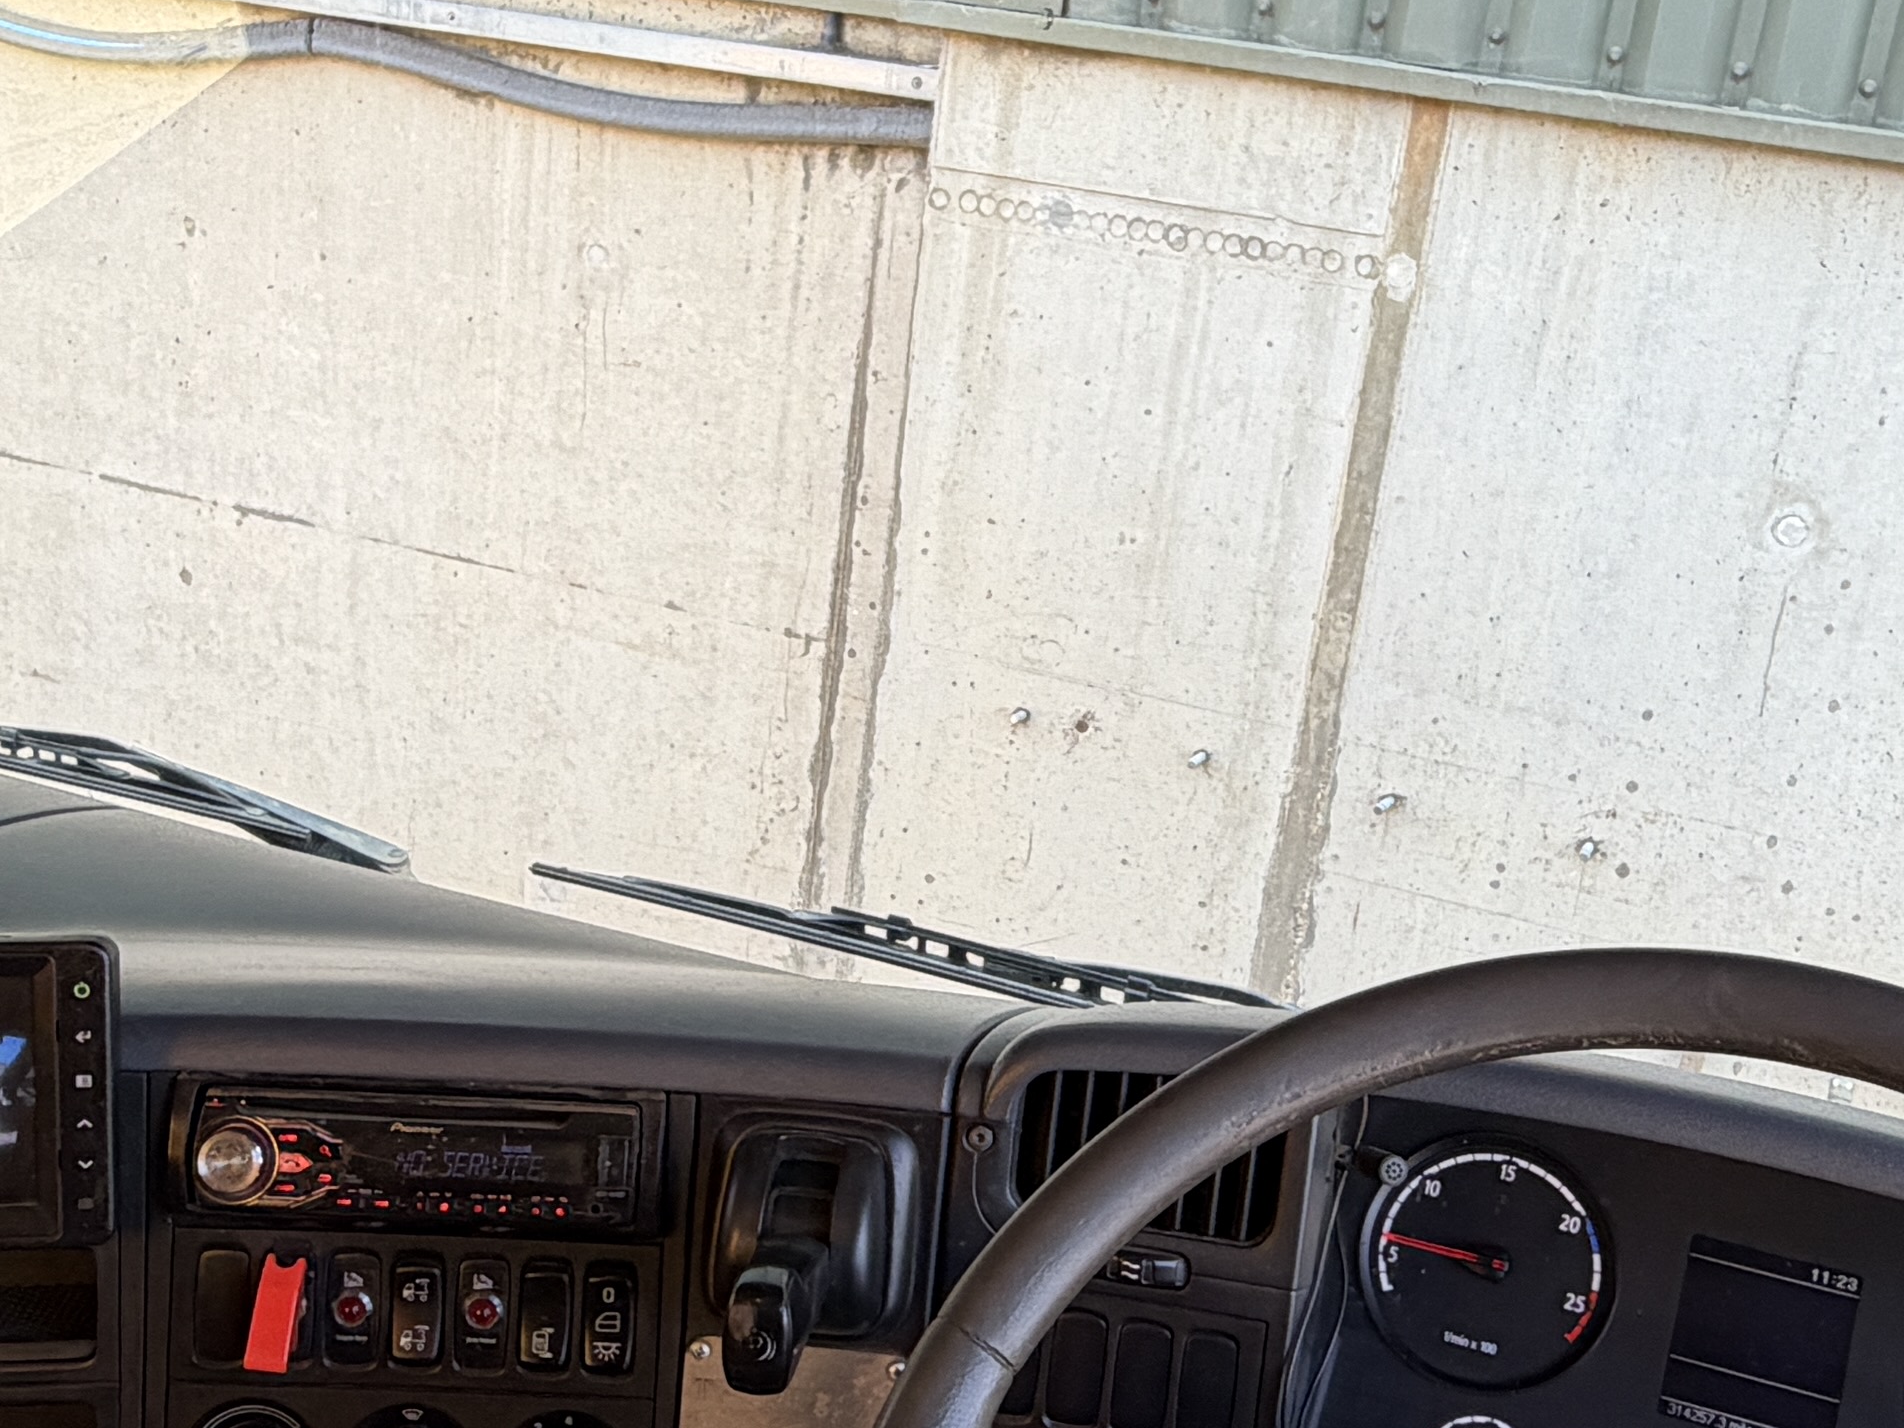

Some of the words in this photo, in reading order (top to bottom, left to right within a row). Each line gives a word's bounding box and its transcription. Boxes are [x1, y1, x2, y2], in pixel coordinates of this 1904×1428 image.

[1499, 1164, 1517, 1182] 15
[1423, 1179, 1442, 1198] 10
[1558, 1213, 1582, 1235] 20
[1388, 1246, 1399, 1264] 5
[1810, 1267, 1859, 1292] 11:23
[1563, 1292, 1587, 1313] 25
